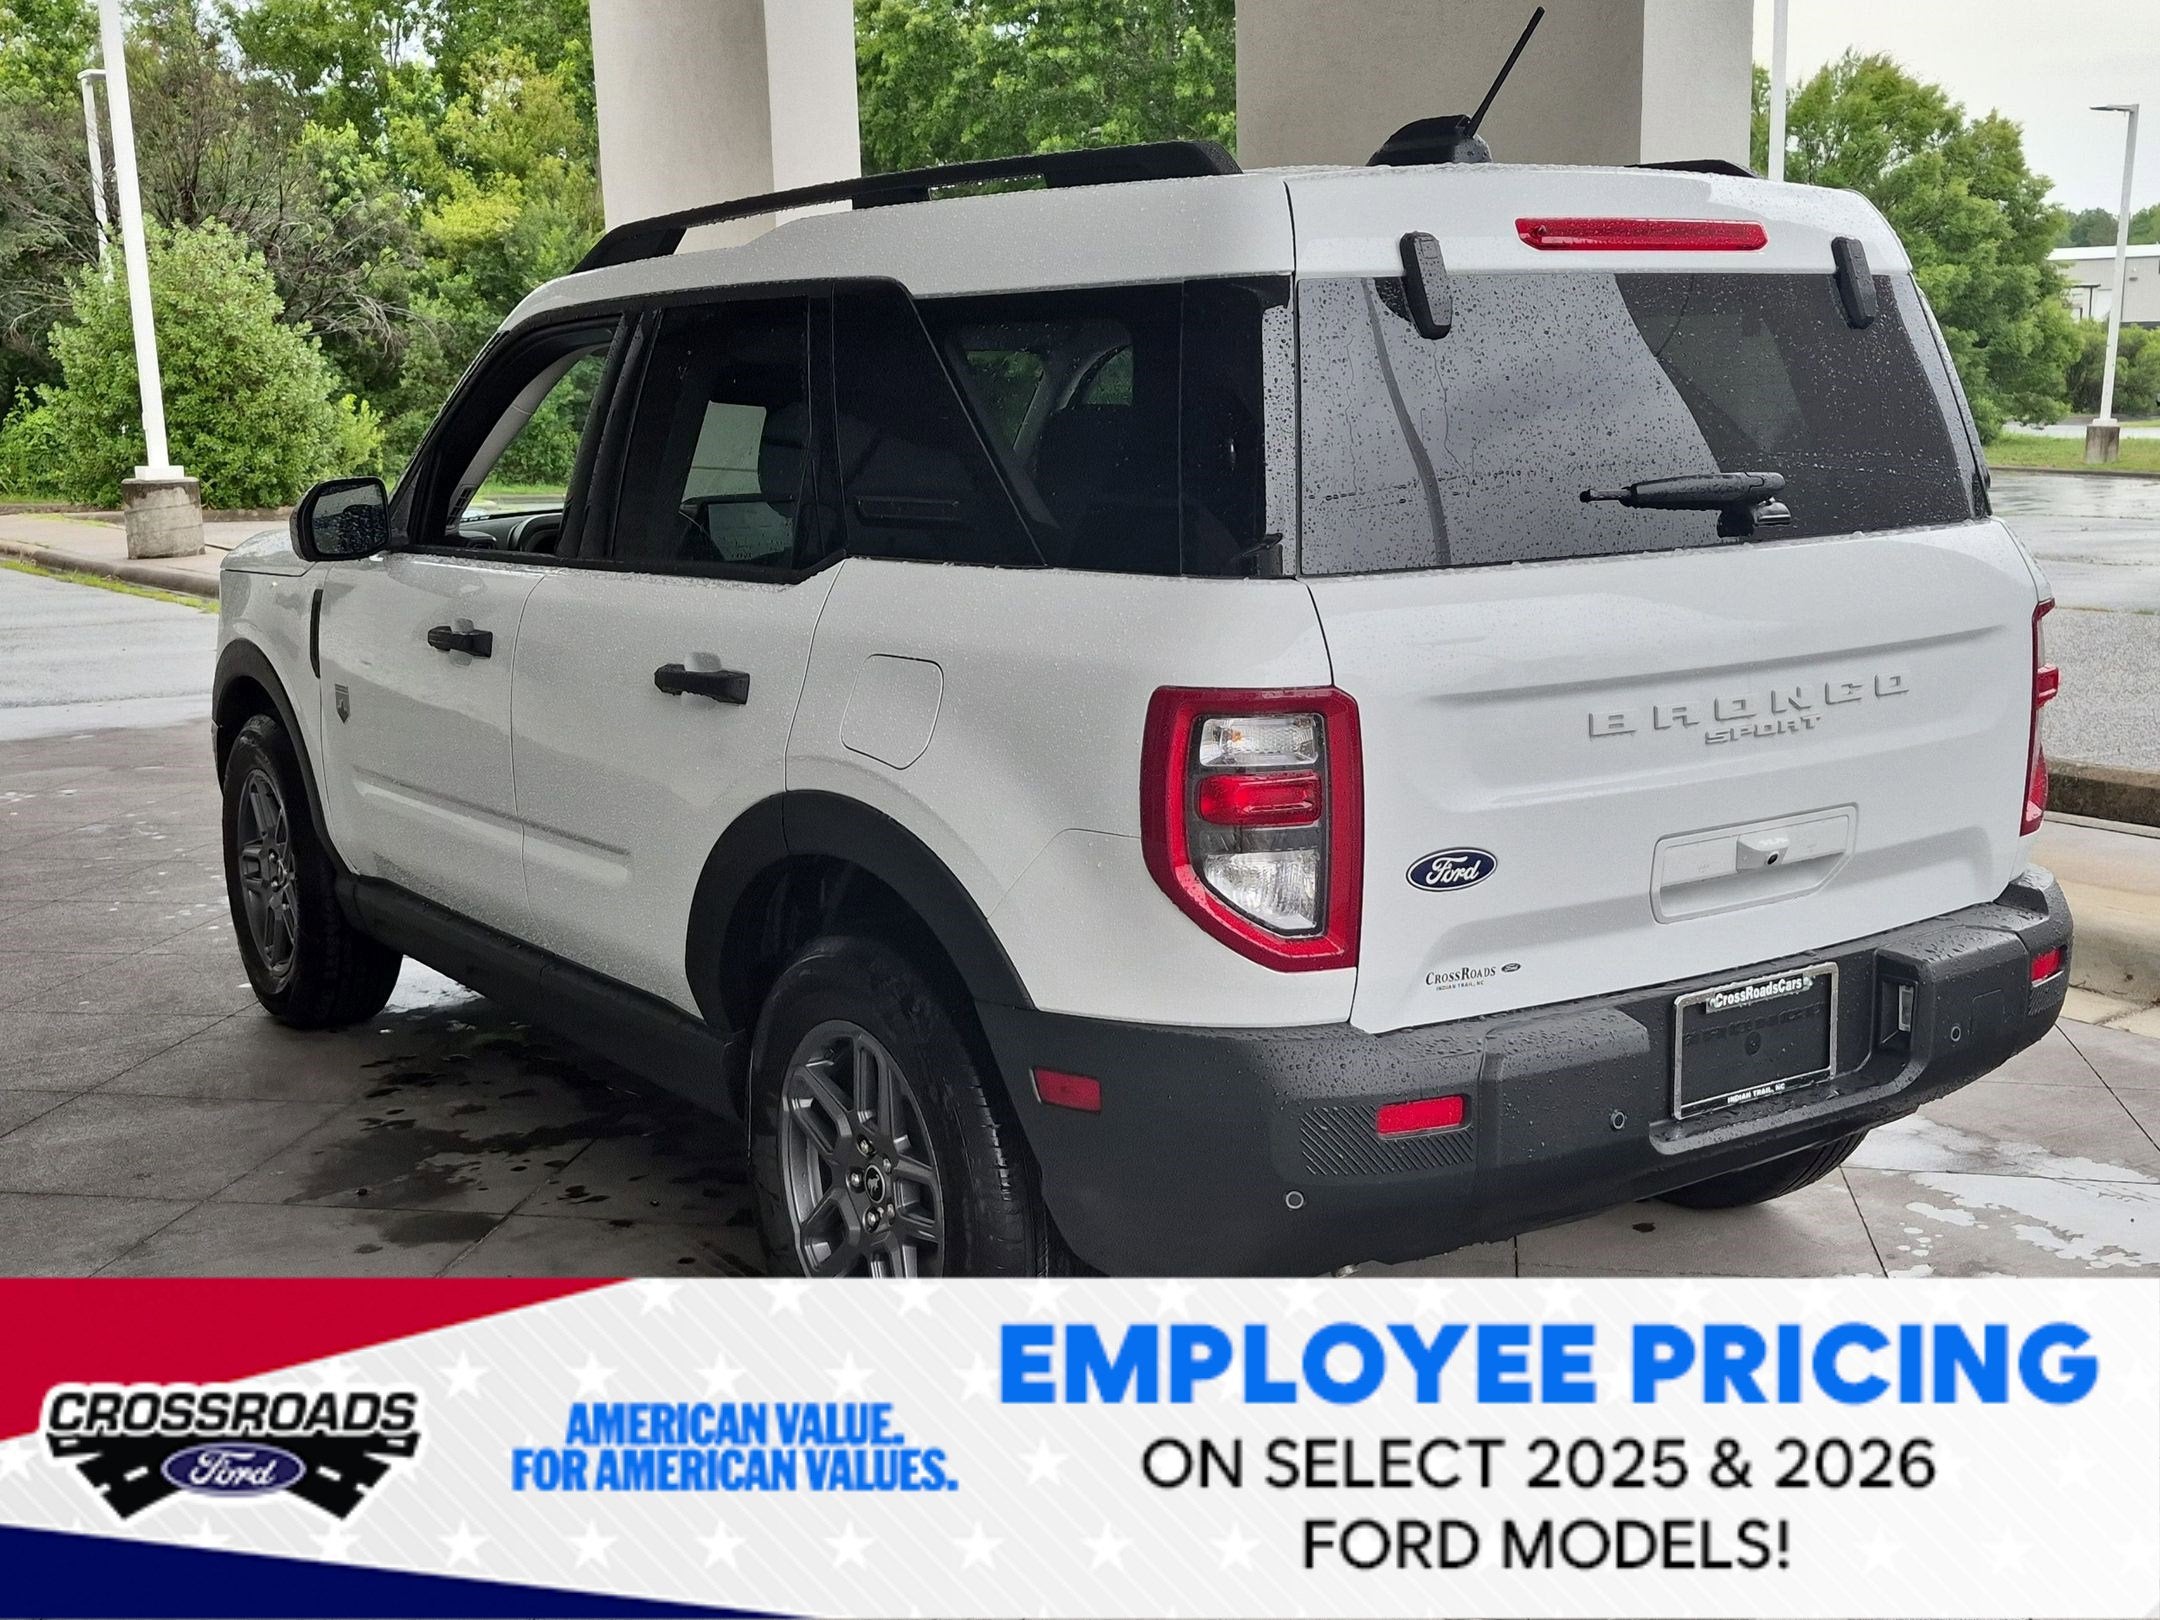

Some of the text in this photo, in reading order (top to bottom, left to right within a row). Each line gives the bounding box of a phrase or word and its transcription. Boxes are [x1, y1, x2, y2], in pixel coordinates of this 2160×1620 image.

[1588, 672, 1911, 737] BRONCO
[1704, 713, 1823, 745] SPORT
[1425, 855, 1482, 886] Ford
[1714, 977, 1803, 1009] CrossRoadsCars
[1727, 1090, 1752, 1104] INDIAN
[1775, 1082, 1786, 1091] NC
